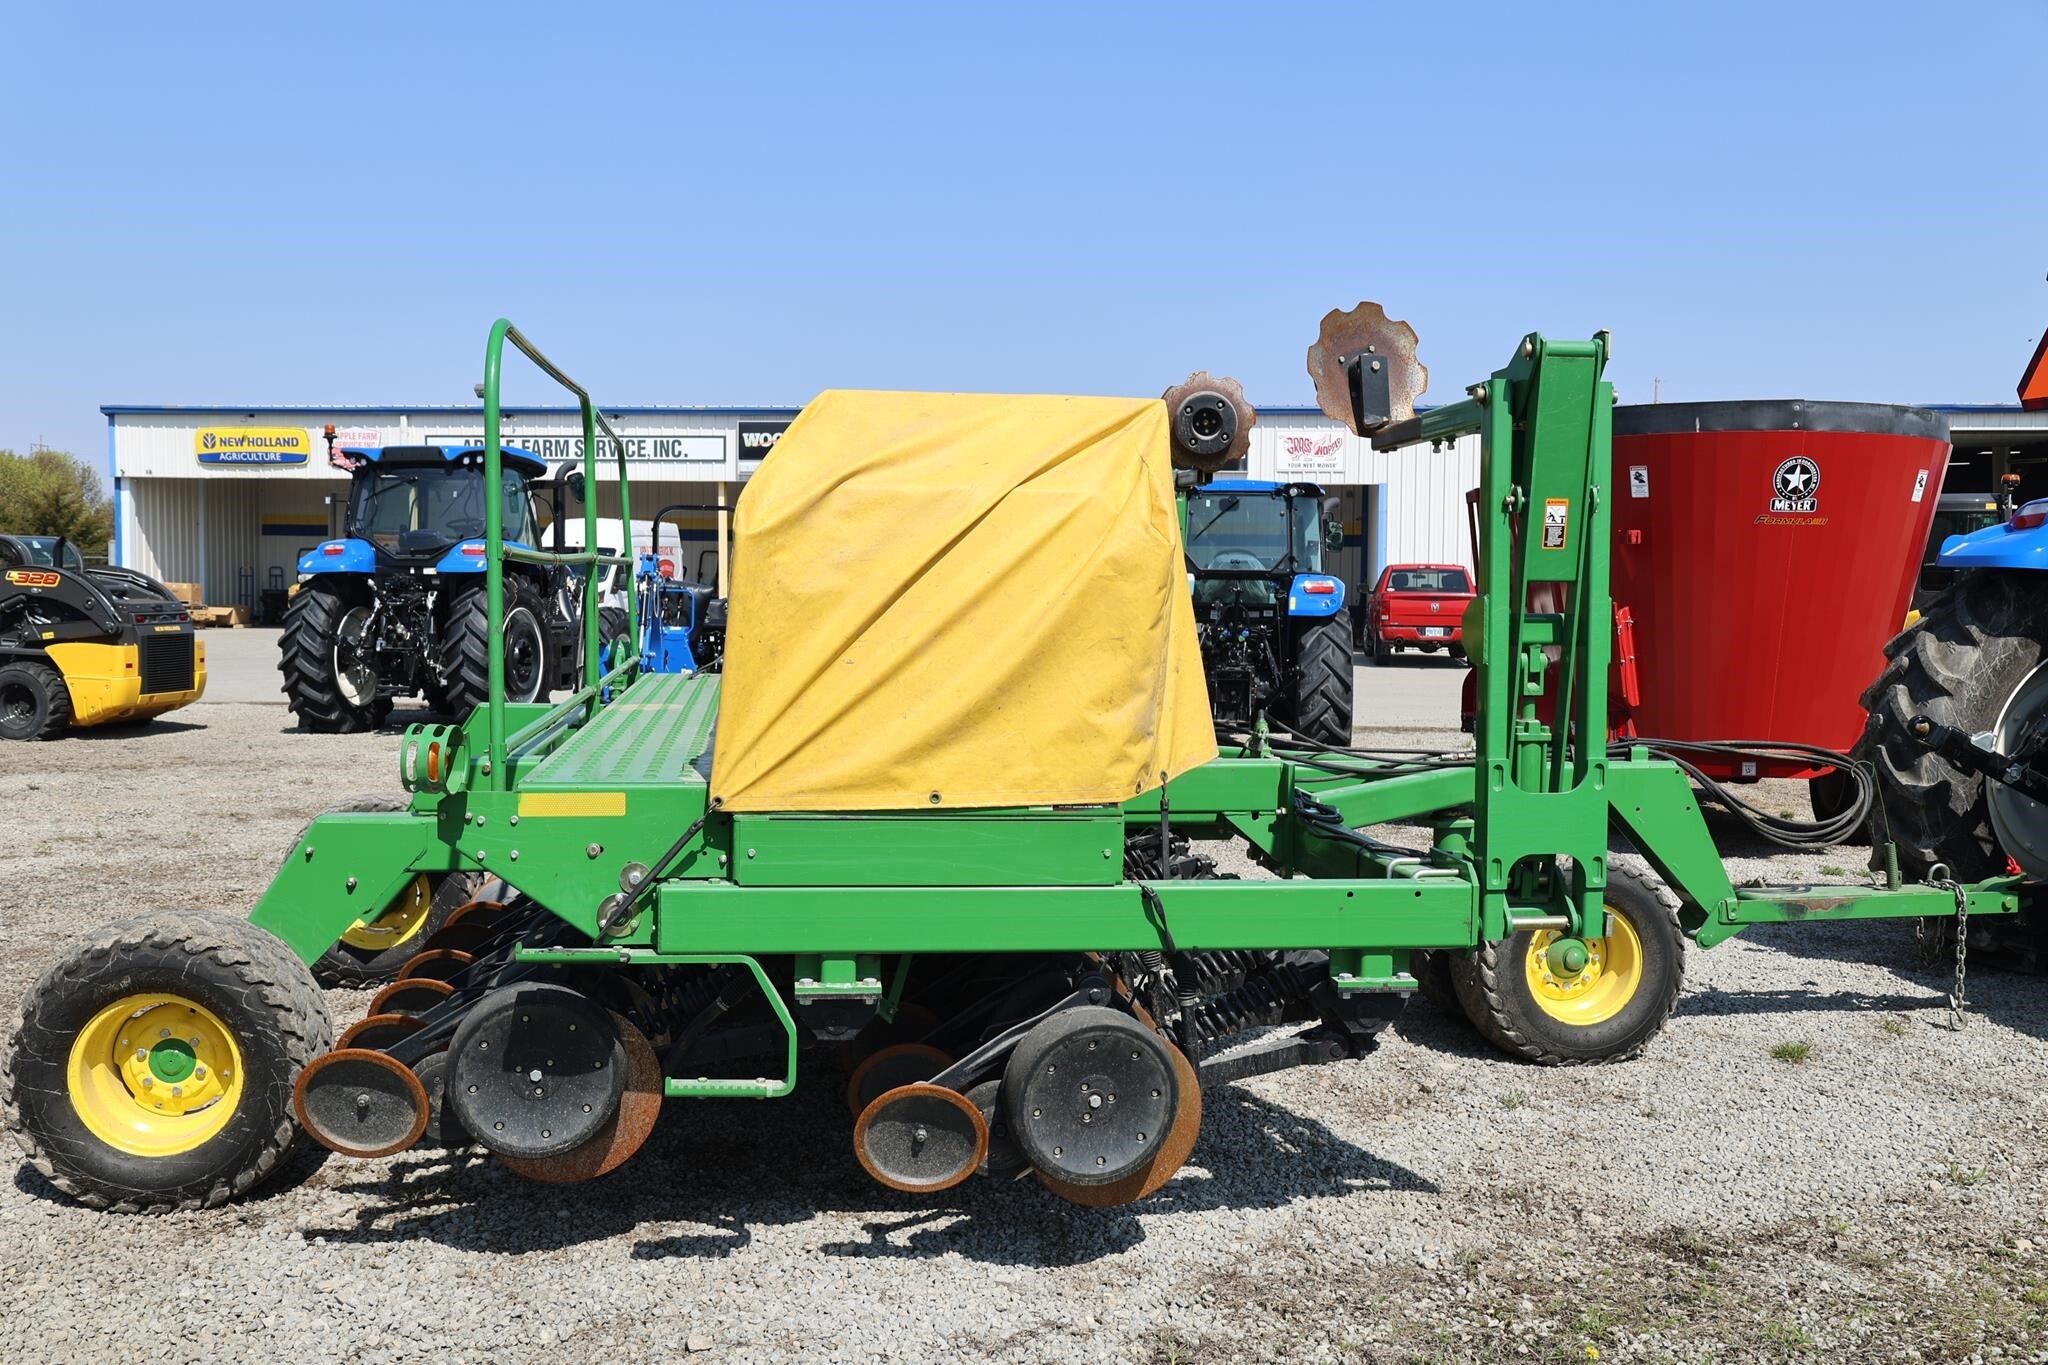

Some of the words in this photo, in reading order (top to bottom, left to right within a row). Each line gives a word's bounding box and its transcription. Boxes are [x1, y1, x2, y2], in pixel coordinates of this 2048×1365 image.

[219, 437, 244, 447] NEW
[247, 437, 299, 447] HOLLAND
[521, 439, 570, 458] FARM
[653, 439, 688, 458] INC.
[219, 452, 281, 461] AGRICULTURE
[5, 570, 60, 587] L328
